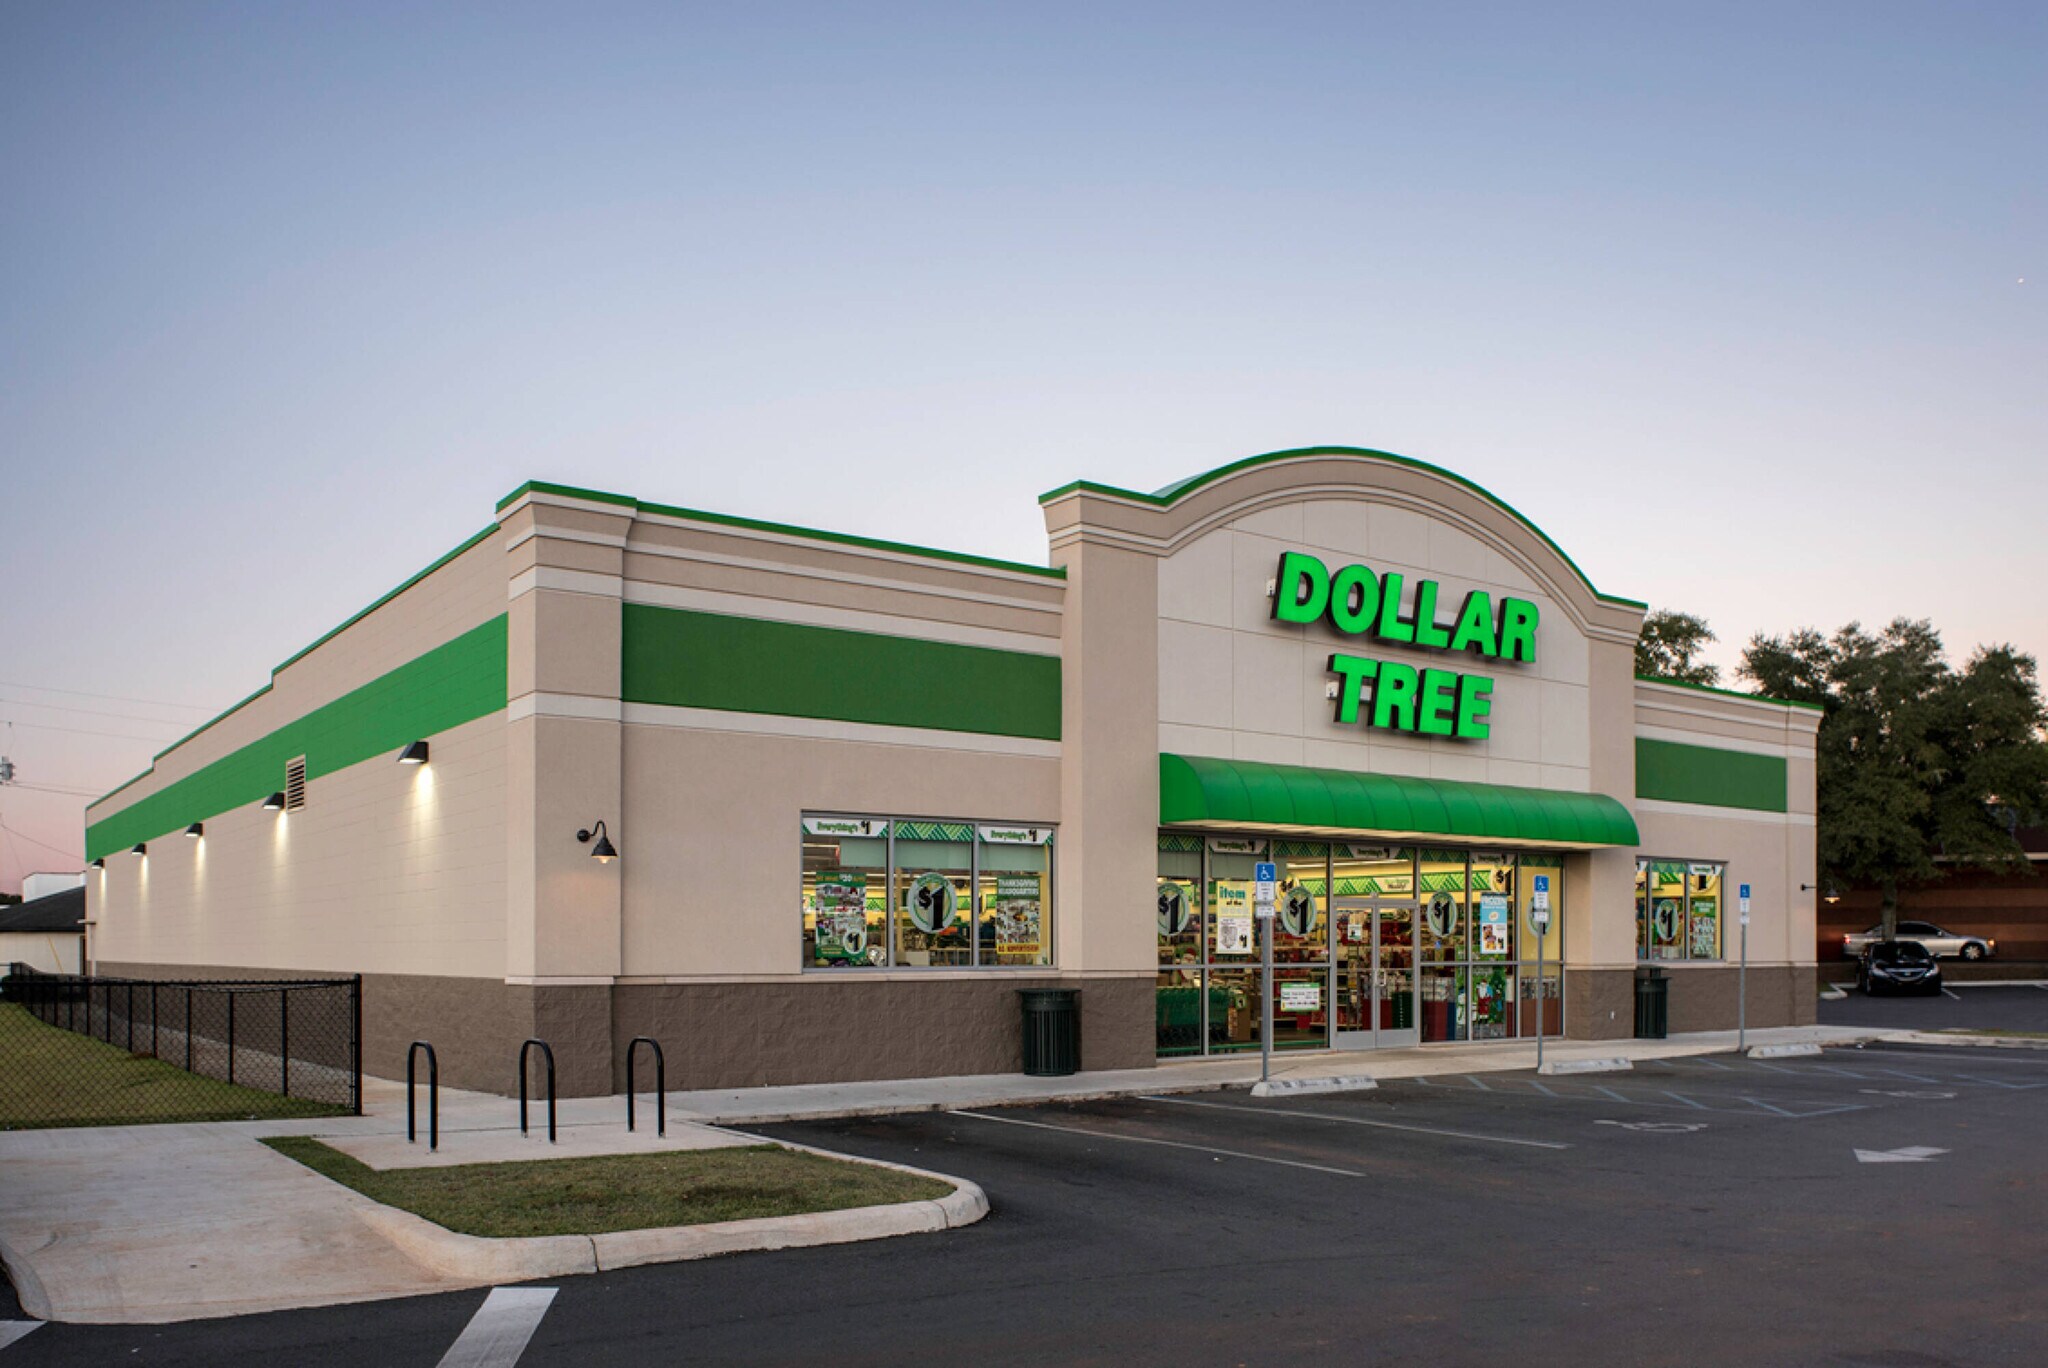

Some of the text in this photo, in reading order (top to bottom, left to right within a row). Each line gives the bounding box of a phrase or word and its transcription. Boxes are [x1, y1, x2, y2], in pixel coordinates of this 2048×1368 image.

[1271, 551, 1540, 663] DOLLAR
[1327, 653, 1494, 740] TREE
[1219, 886, 1246, 899] item
[1496, 868, 1512, 896] $1
[918, 887, 945, 931] $1
[1158, 894, 1180, 934] $1
[1289, 896, 1309, 935] $1
[1434, 900, 1450, 935] $1
[1661, 908, 1673, 938] $1
